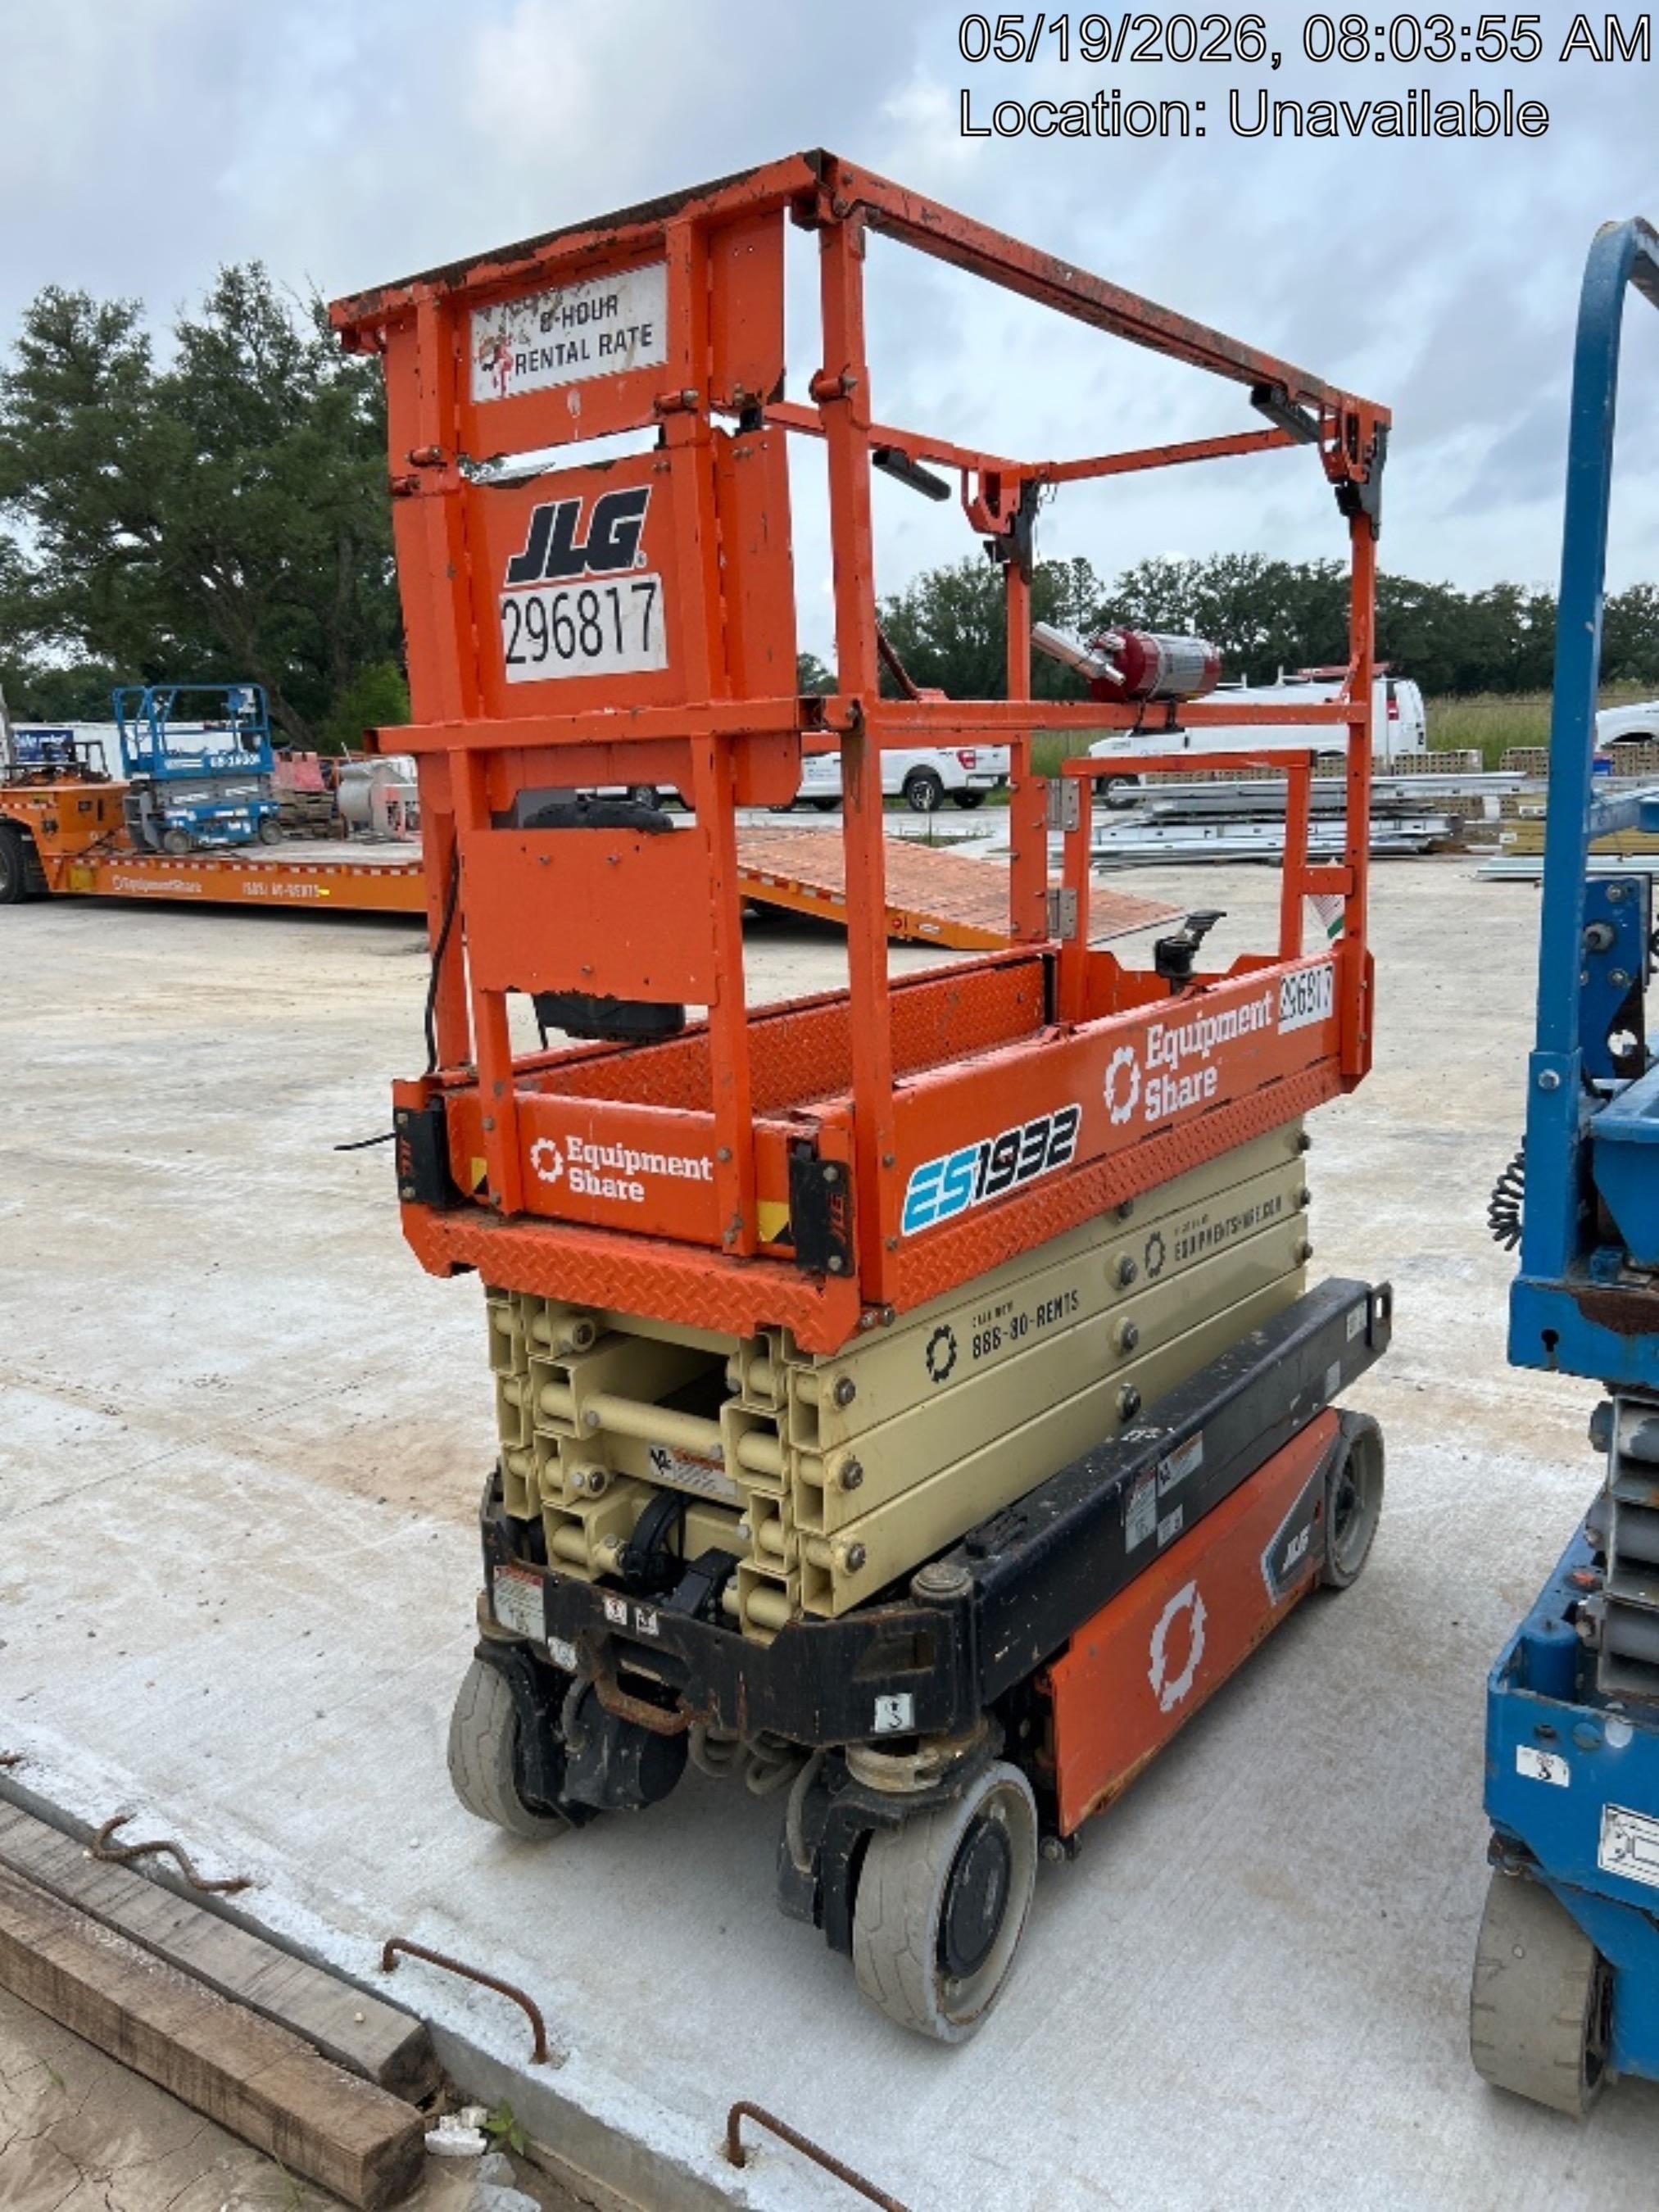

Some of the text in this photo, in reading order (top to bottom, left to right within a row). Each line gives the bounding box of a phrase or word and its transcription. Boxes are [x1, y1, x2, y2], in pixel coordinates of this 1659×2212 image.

[515, 324, 653, 376] RENTAL RATE
[505, 486, 652, 585] JLG
[501, 582, 656, 664] 296817
[1146, 989, 1273, 1070] Equipment
[1145, 1067, 1217, 1122] Share
[565, 1135, 714, 1182] Equipment
[569, 1170, 646, 1203] Share
[903, 1104, 1081, 1236] ES1932
